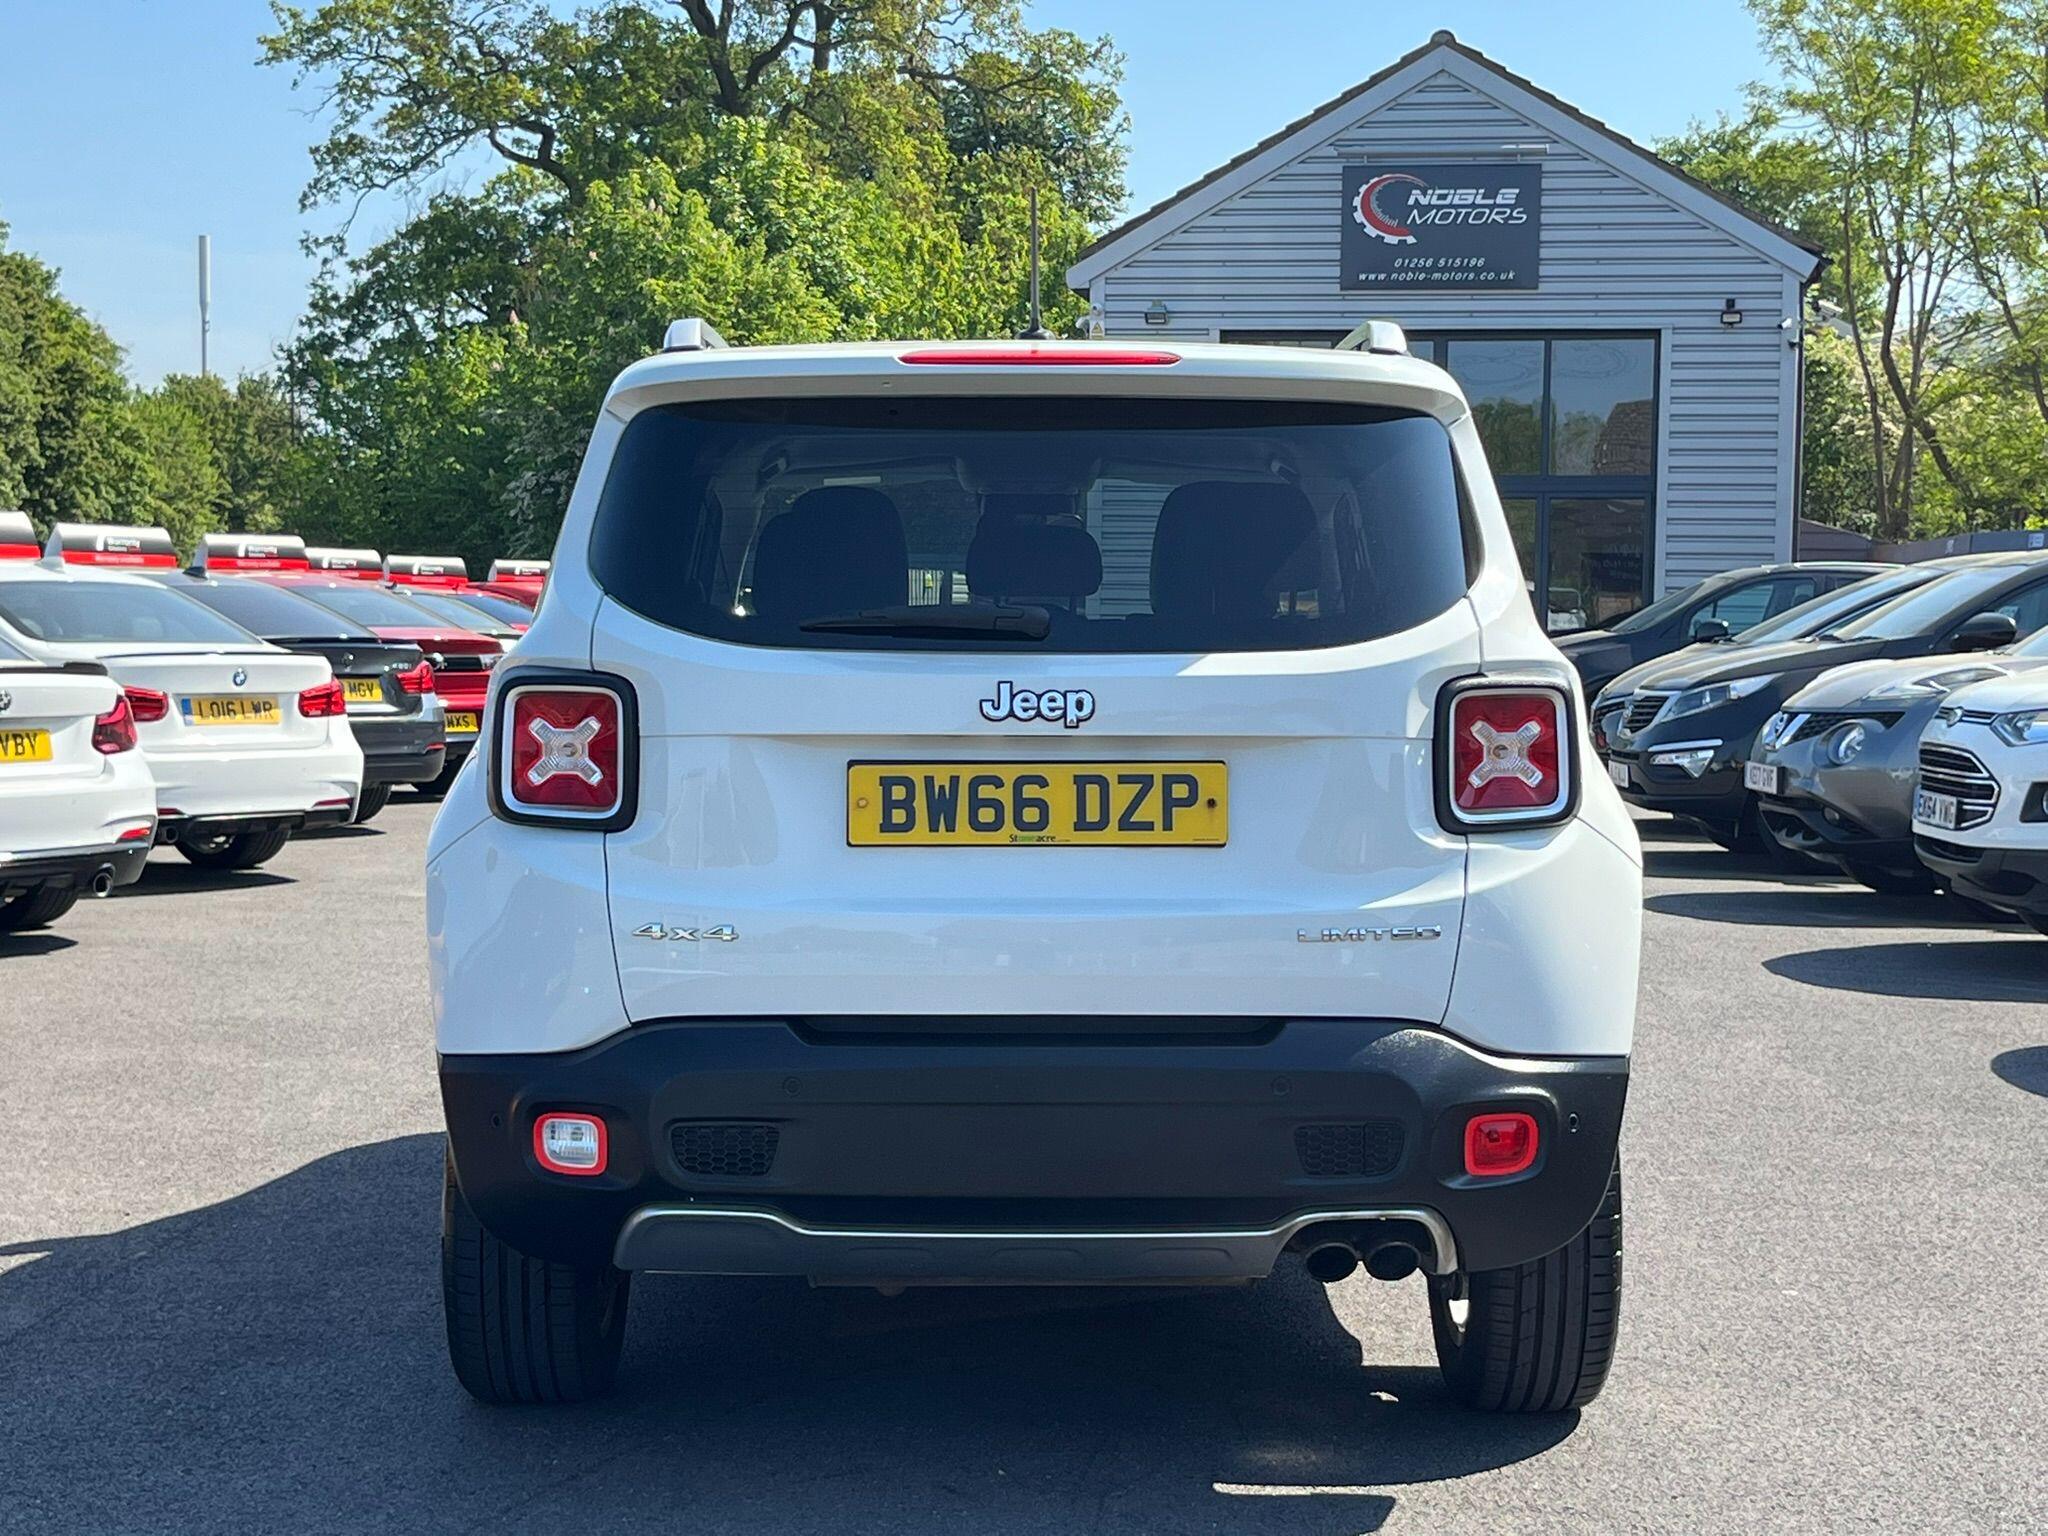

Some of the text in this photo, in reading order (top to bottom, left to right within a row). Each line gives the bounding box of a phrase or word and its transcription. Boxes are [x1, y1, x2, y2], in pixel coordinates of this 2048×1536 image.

[1407, 188, 1520, 206] NOBLE
[1406, 207, 1527, 225] MOTORS
[1394, 257, 1485, 268] 01256 515196
[980, 681, 1095, 728] Jeep
[879, 774, 1199, 833] BW66 DZP
[632, 922, 739, 942] 4x4
[1297, 926, 1441, 943] LIMITED
